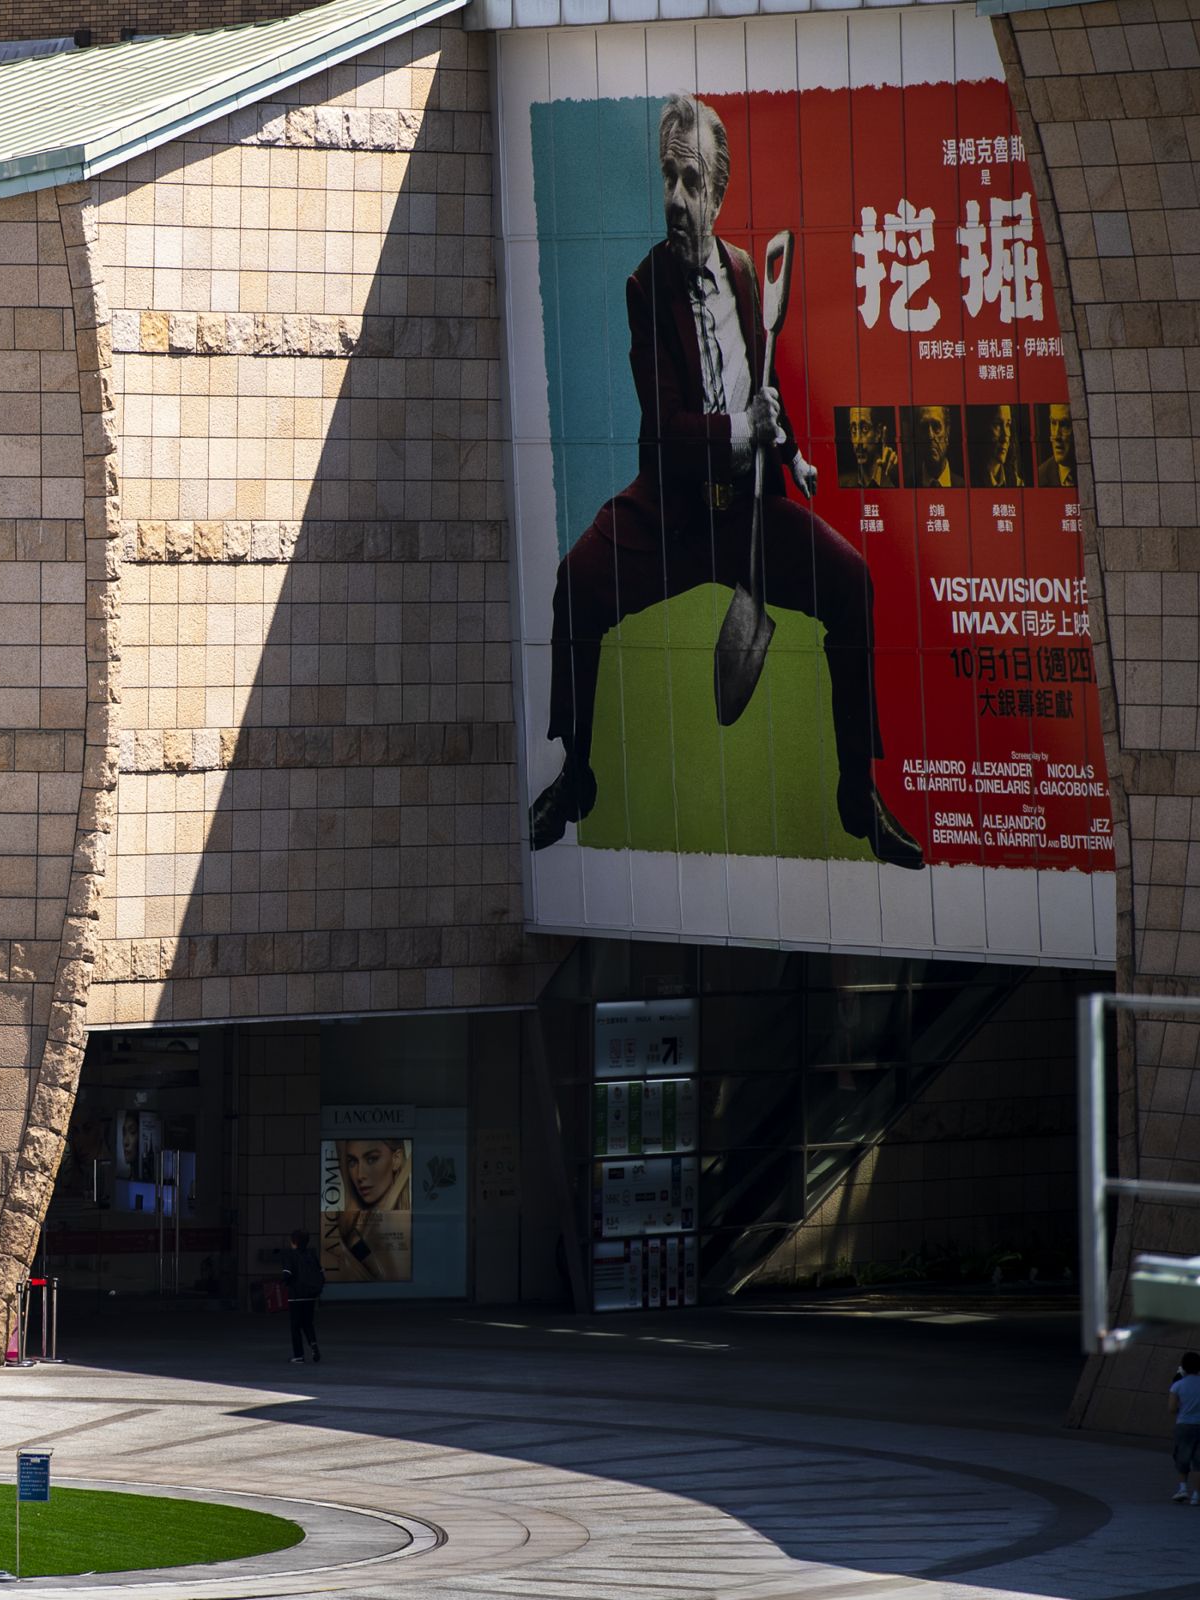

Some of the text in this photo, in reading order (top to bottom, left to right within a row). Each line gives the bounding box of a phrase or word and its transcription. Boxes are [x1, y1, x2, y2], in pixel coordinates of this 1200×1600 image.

[981, 169, 991, 186] 是
[853, 192, 1043, 332] 挖掘
[978, 365, 1014, 380] 導演作品
[992, 504, 1016, 517] 桑德拉
[926, 519, 950, 532] 古德曼
[930, 577, 1071, 604] VISTAVISION
[952, 610, 1092, 637] IMAX 同步上映
[950, 646, 1097, 683] 10月1日(週四
[980, 688, 1074, 718] 大銀幕鉅獻
[1041, 752, 1049, 763] by
[902, 759, 966, 775] ALEJANDRO
[971, 761, 1033, 778] ALEXANDER
[975, 779, 1031, 795] DINELARIS
[1039, 781, 1104, 797] GIACOBONE
[1022, 804, 1045, 815] Story by
[934, 812, 1111, 833] SABINA ALEJANDRO JEZ
[932, 829, 977, 844] BERMAN
[1047, 840, 1060, 848] AND
[1060, 834, 1116, 850] BUTTERW
[334, 1107, 405, 1125] LANCÔME
[321, 1148, 341, 1273] LANCÔME
